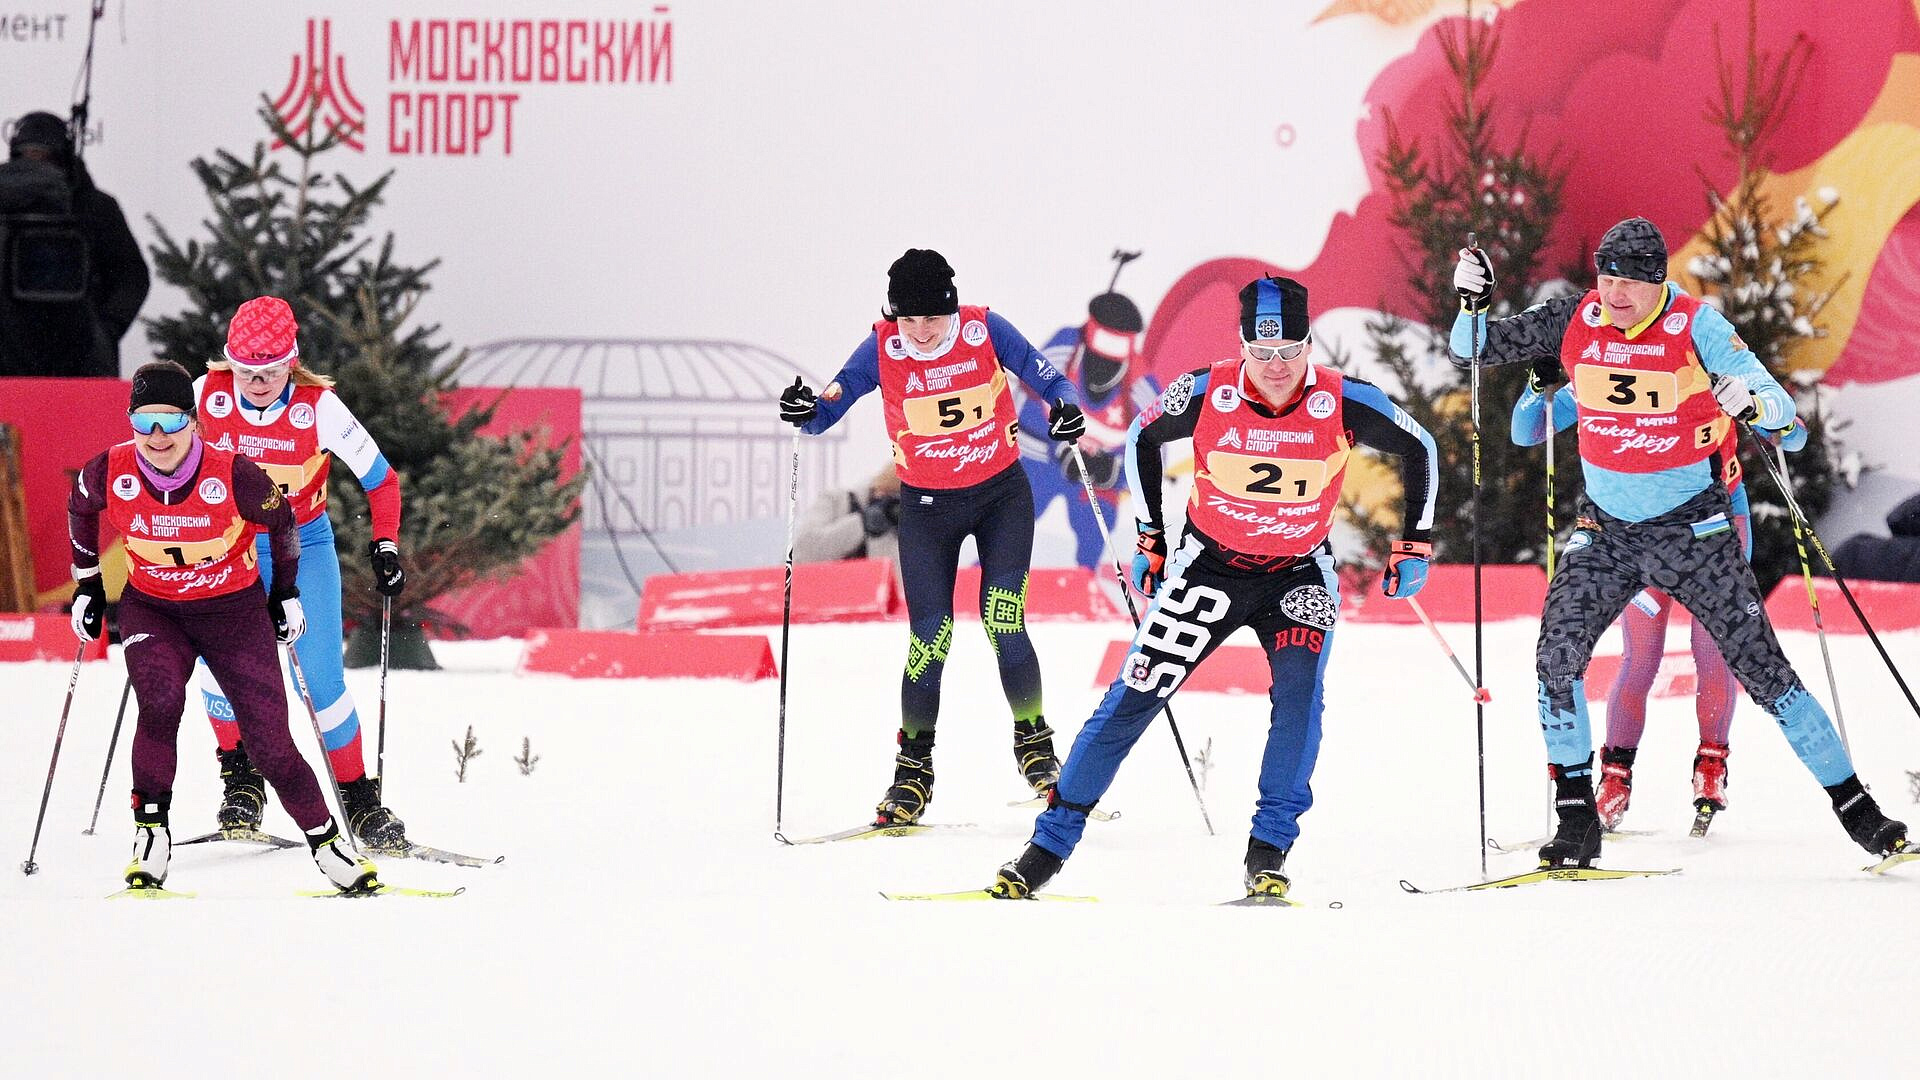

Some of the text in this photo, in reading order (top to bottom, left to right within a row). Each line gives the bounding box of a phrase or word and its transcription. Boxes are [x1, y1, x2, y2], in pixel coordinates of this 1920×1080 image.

[388, 5, 672, 83] МОСКОВСКИЙ
[388, 92, 520, 155] СПОРТ
[1604, 352, 1632, 364] СПОРТ
[1606, 342, 1664, 356] МОСКОВСКИЙ
[924, 358, 978, 379] МОСКОВСКИЙ
[927, 377, 952, 391] СПОРТ
[1606, 373, 1659, 408] 3 1
[937, 397, 982, 428] 5 1
[1247, 429, 1315, 444] МОСКОВСКИЙ
[1581, 416, 1638, 438] Гонка
[1701, 426, 1712, 444] 3
[237, 446, 265, 458] СПОРТ
[238, 434, 295, 452] МОСКОВСКИЙ
[914, 438, 971, 459] Гонка
[1245, 441, 1280, 453] СПОРТ
[1612, 435, 1681, 454] звёзд
[790, 452, 799, 502] FISCHER
[1246, 463, 1307, 496] 2 1
[1081, 469, 1102, 515] FISCHER
[1207, 495, 1277, 525] Гонка
[151, 514, 211, 528] МОСКОВСКИЙ
[152, 526, 180, 537] СПОРТ
[1811, 535, 1836, 571] FISCHER
[1122, 576, 1231, 698] SBS
[1274, 626, 1323, 654] RUS
[203, 695, 236, 718] USS
[1547, 871, 1579, 880] FISCHER
